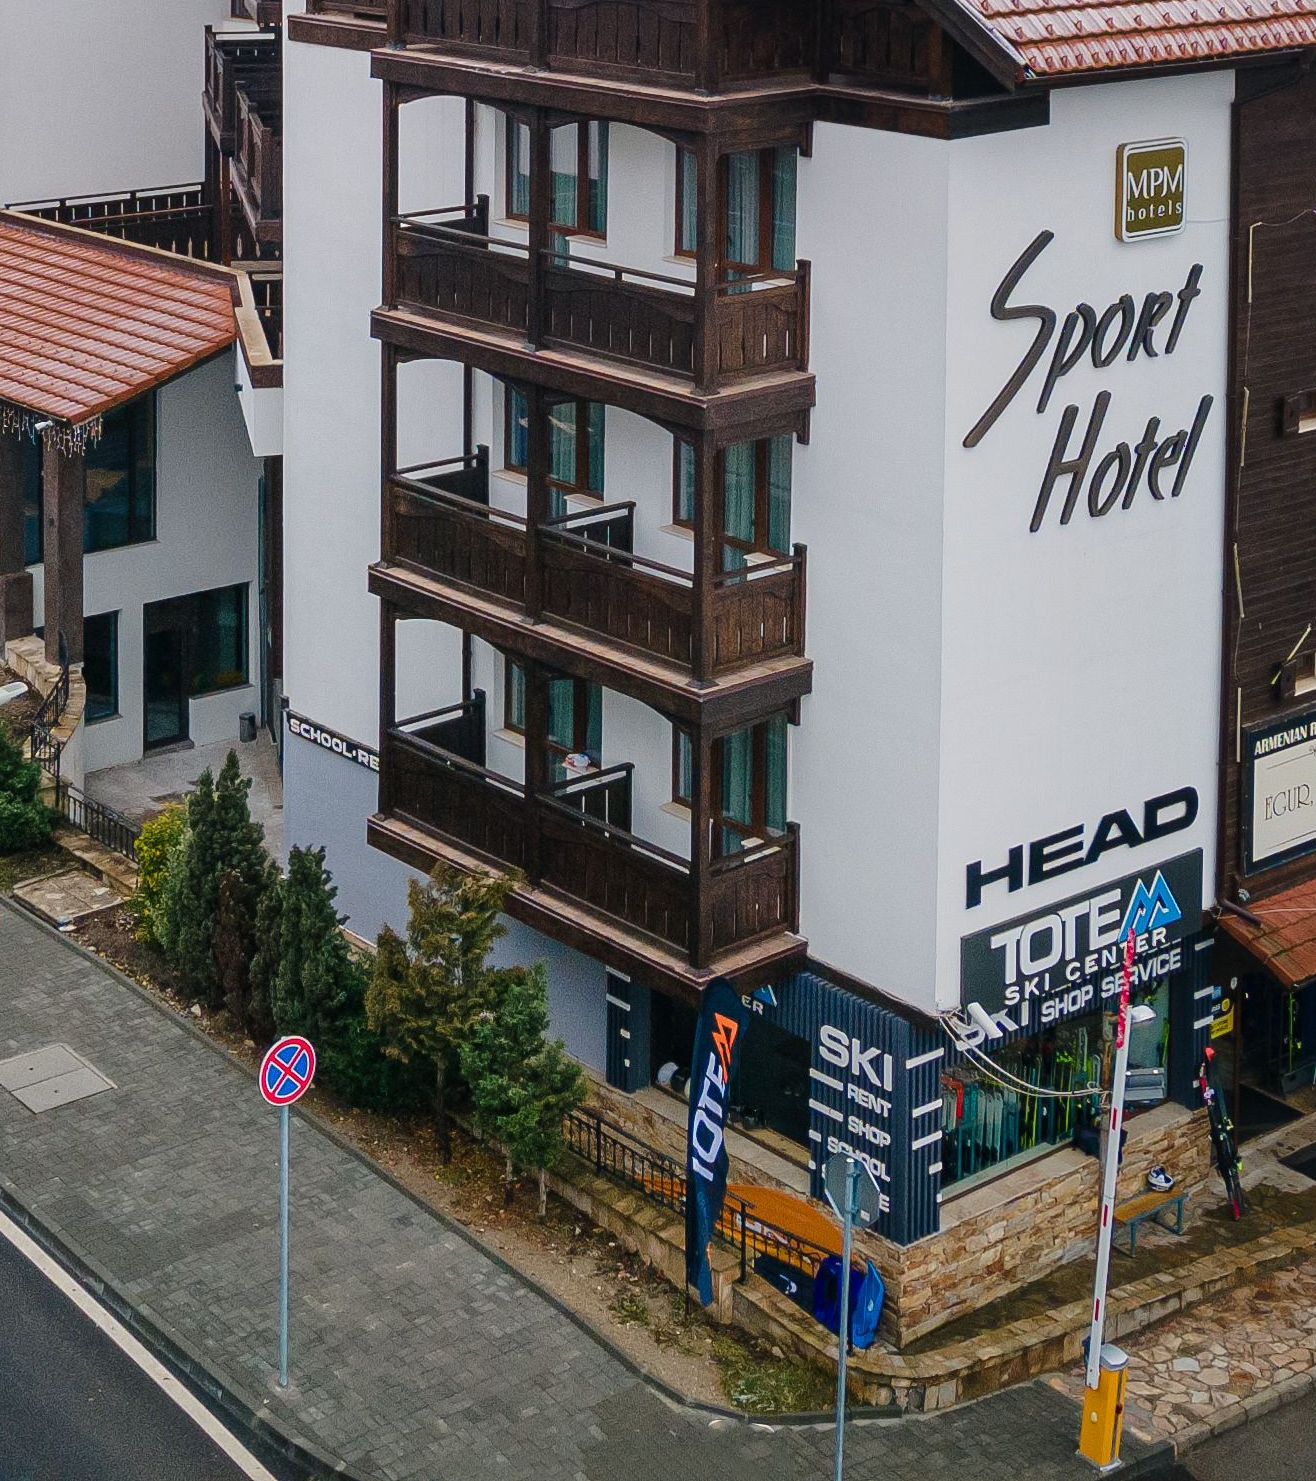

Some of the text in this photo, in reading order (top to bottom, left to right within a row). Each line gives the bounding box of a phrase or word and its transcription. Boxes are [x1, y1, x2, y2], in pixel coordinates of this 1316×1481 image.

[1127, 164, 1183, 201] MPM
[1126, 199, 1183, 222] hotels
[1029, 390, 1214, 532] Hotel
[1254, 725, 1308, 756] ARMENIAN
[1264, 783, 1314, 821] EGUR,
[965, 786, 1199, 910] HEAD
[990, 869, 1182, 985] TOTEM
[1004, 973, 1050, 1006] SKI
[1041, 984, 1093, 1023] SHOP
[819, 1025, 892, 1092] SKI
[847, 1083, 892, 1118] RENT
[848, 1115, 891, 1148] SHOP
